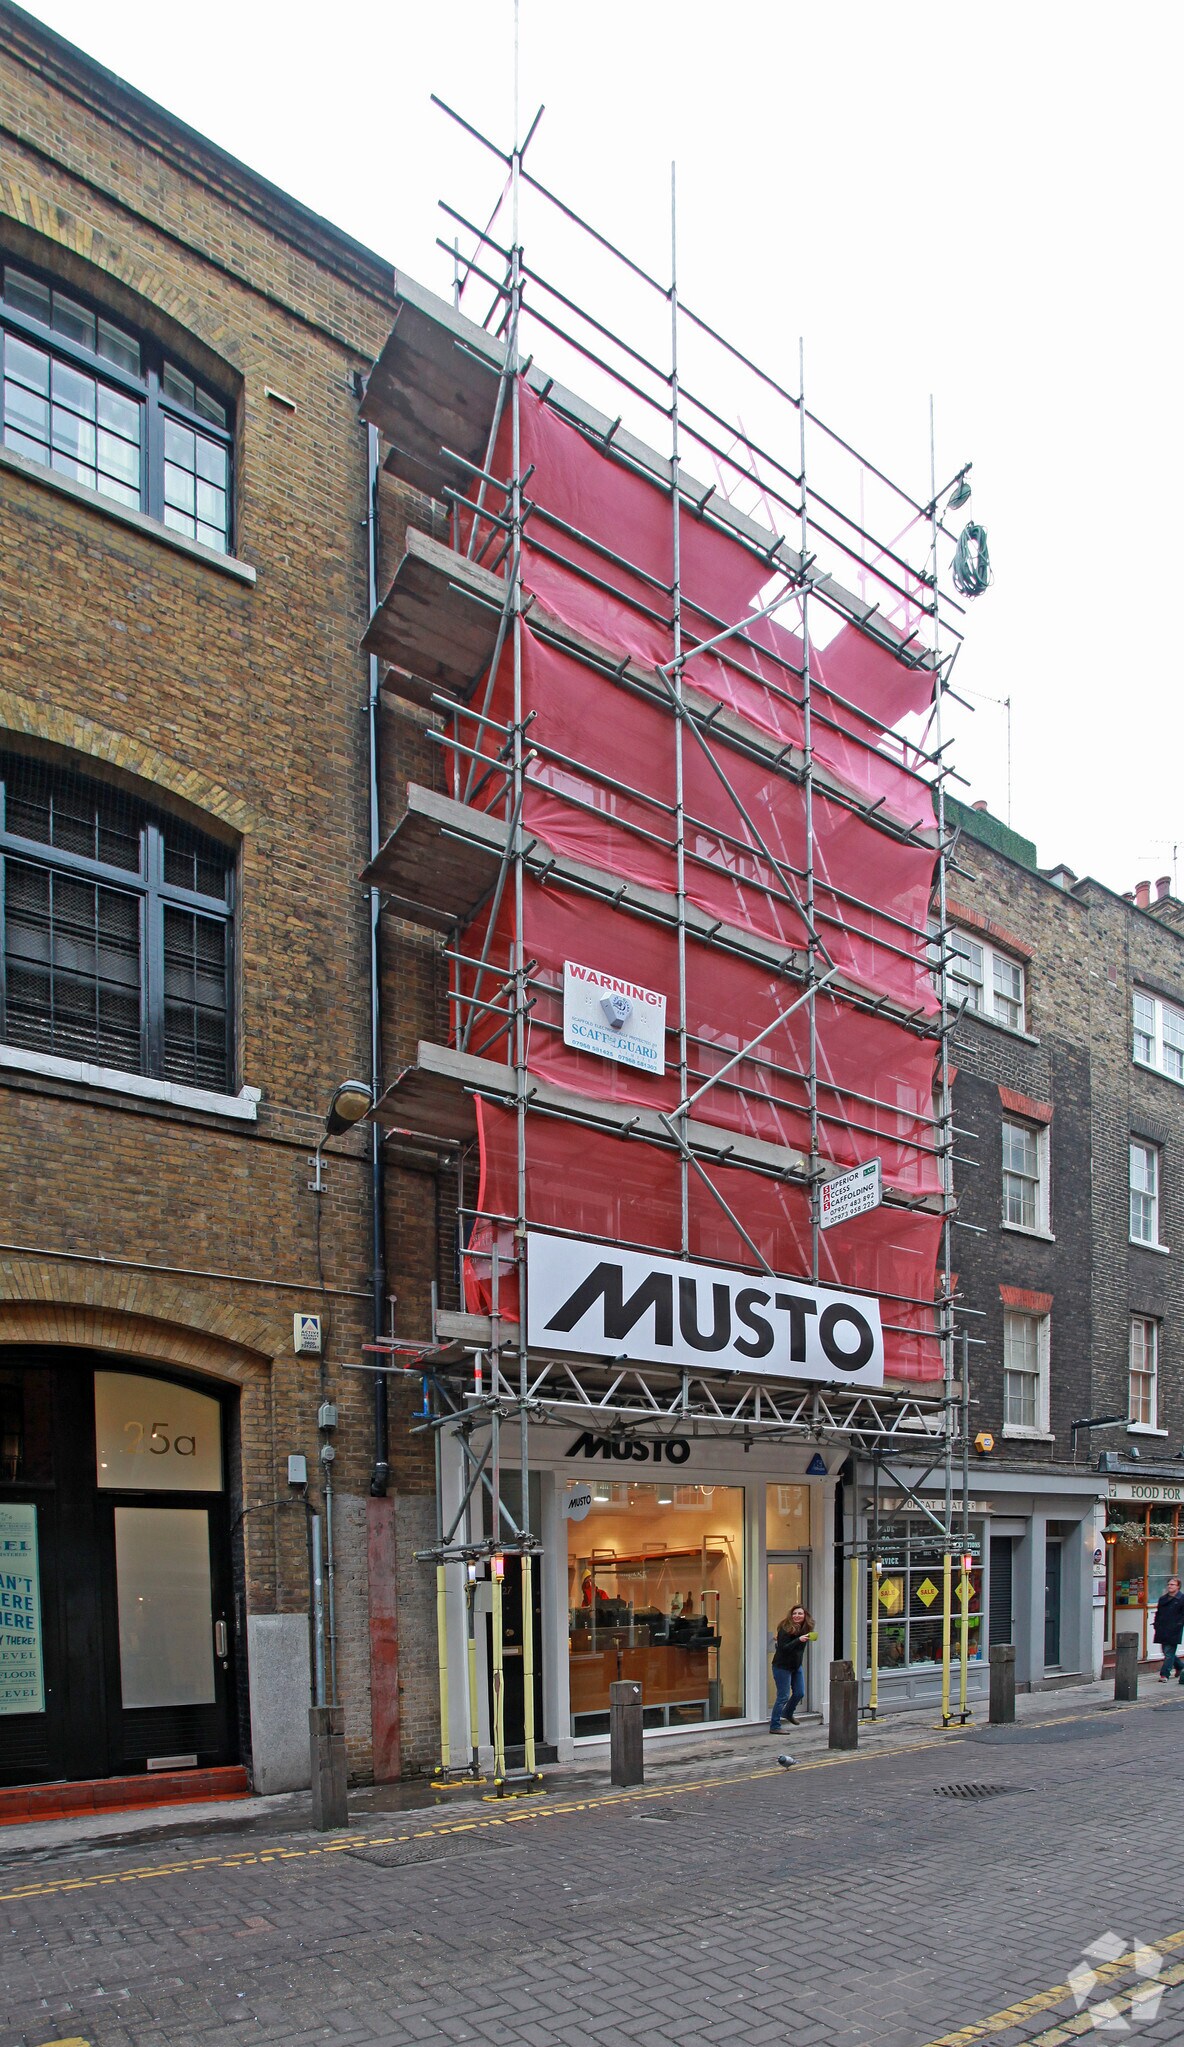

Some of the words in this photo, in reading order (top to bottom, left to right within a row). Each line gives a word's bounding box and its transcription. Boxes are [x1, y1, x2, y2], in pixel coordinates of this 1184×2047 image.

[569, 964, 663, 1008] WARNING!
[863, 1192, 875, 1201] 892
[829, 1211, 849, 1224] 07973
[863, 1200, 875, 1210] 225
[543, 1261, 875, 1372] MUSTO
[123, 1421, 197, 1456] 25a
[564, 1431, 691, 1465] MUSTO
[1131, 1485, 1160, 1499] FOOD
[1162, 1487, 1182, 1501] FOR
[568, 1494, 592, 1510] MUSTO
[502, 1586, 513, 1595] 27
[880, 1589, 896, 1598] SALE
[920, 1588, 935, 1596] SALE
[6, 1634, 36, 1646] THERE!
